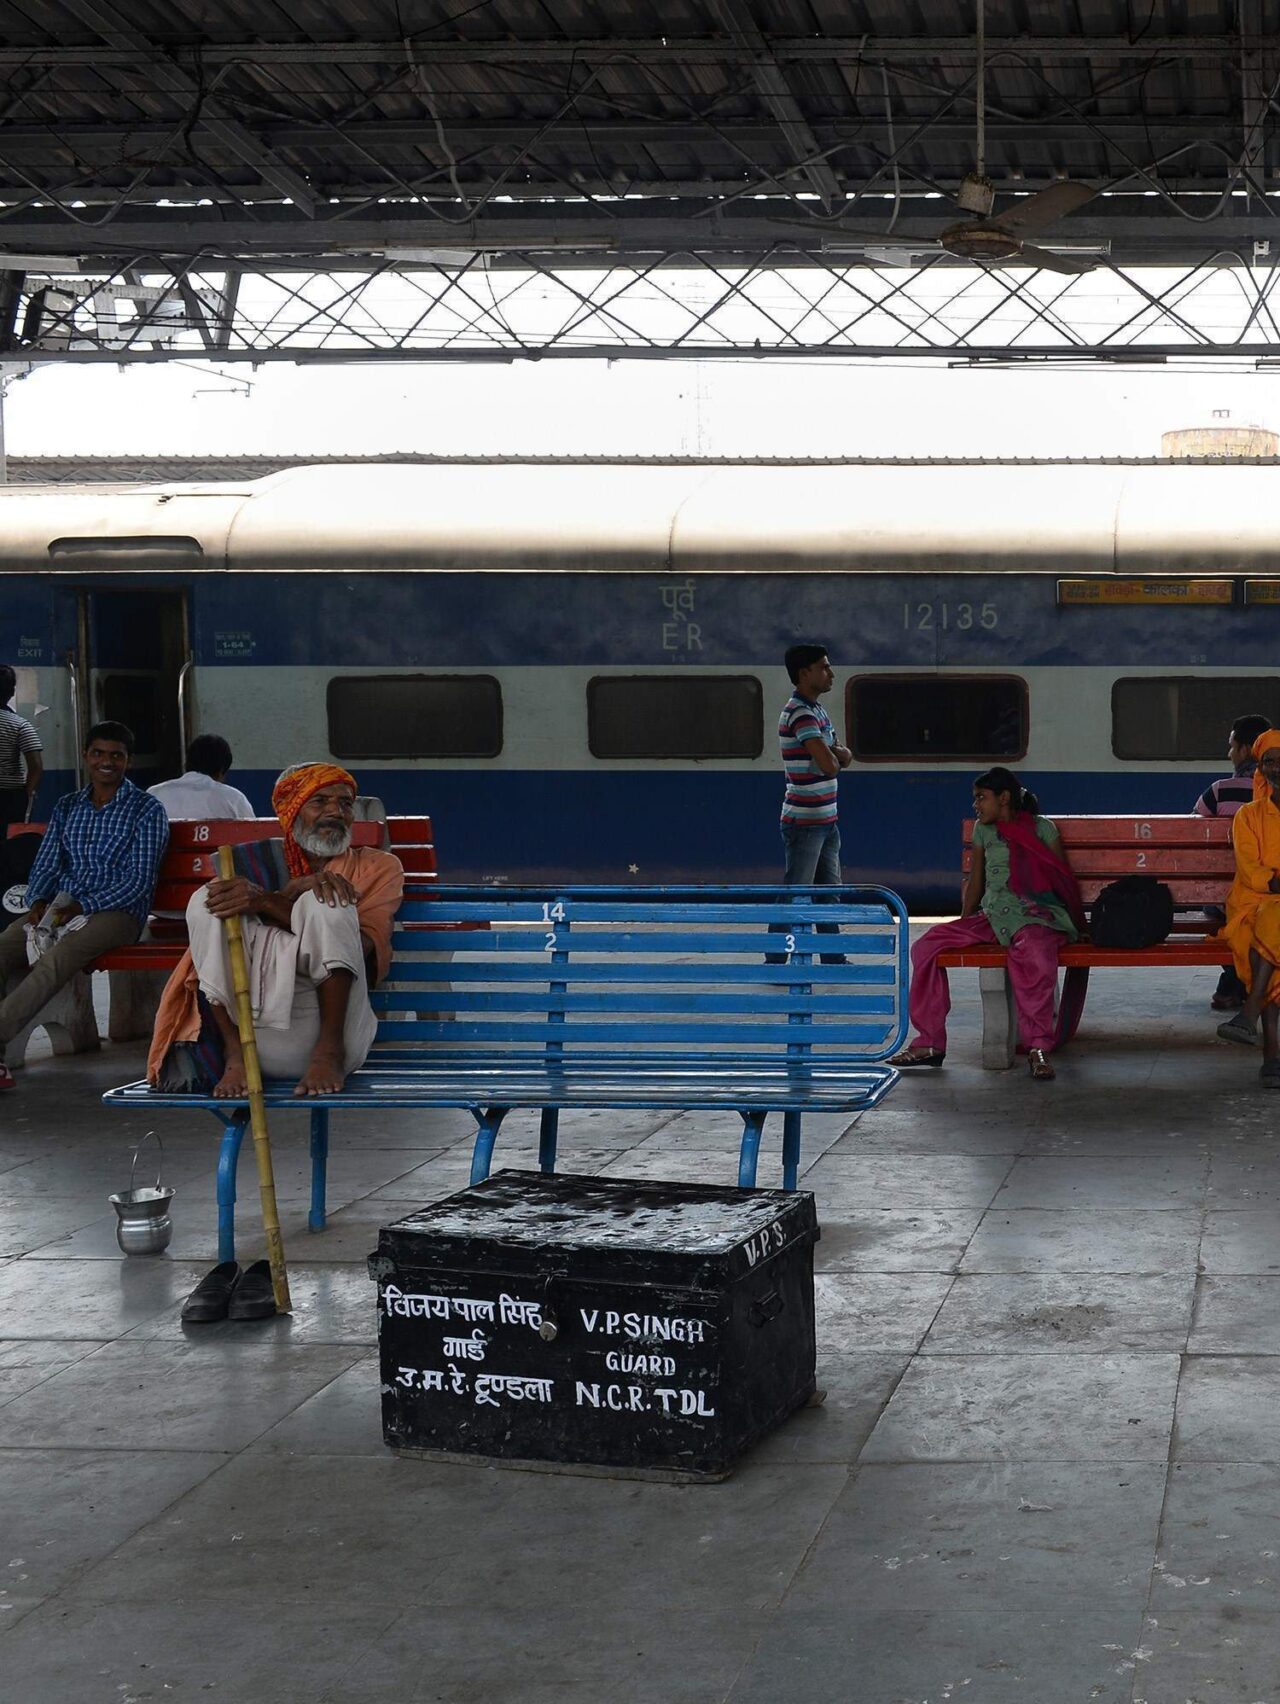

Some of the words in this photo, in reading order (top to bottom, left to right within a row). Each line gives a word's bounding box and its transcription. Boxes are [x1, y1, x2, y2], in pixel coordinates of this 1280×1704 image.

[659, 579, 697, 622] पूर्व
[904, 603, 998, 630] 12135
[18, 648, 44, 658] EXIT
[193, 825, 209, 842] 18
[1134, 823, 1152, 839] 16
[193, 857, 202, 872] 2
[1136, 852, 1146, 867] 2
[542, 903, 565, 921] 14
[544, 933, 557, 952] 2
[785, 934, 795, 953] 3
[382, 1284, 450, 1320] विजय
[452, 1297, 496, 1323] पाल
[499, 1293, 544, 1331] सिंह
[443, 1329, 488, 1361] गार्ड
[606, 1351, 676, 1376] GUARD
[475, 1374, 554, 1408] टूण्डला
